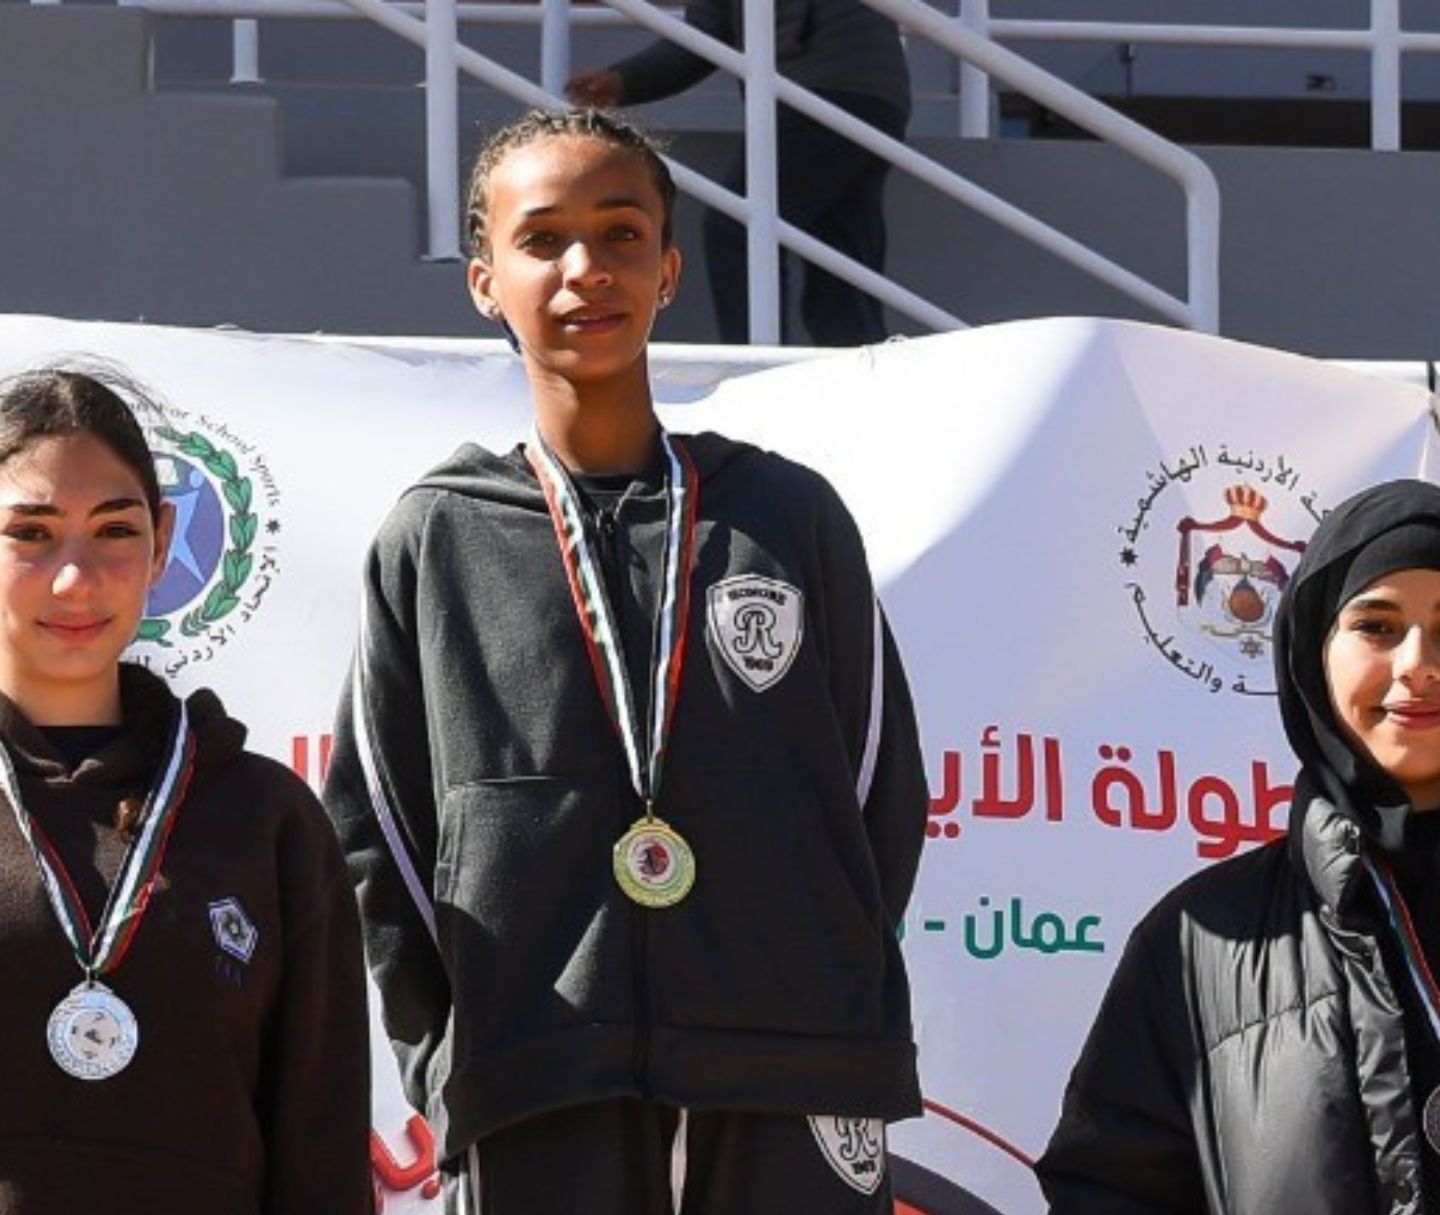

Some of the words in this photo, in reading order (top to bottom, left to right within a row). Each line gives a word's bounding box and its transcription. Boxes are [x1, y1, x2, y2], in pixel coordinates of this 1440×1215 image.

[196, 412, 257, 455] School
[248, 452, 281, 507] Sports
[1117, 445, 1208, 543] الهاشمية
[1218, 444, 1301, 491] الأردنية
[1091, 744, 1295, 859] طولة
[964, 896, 1105, 959] عمان
